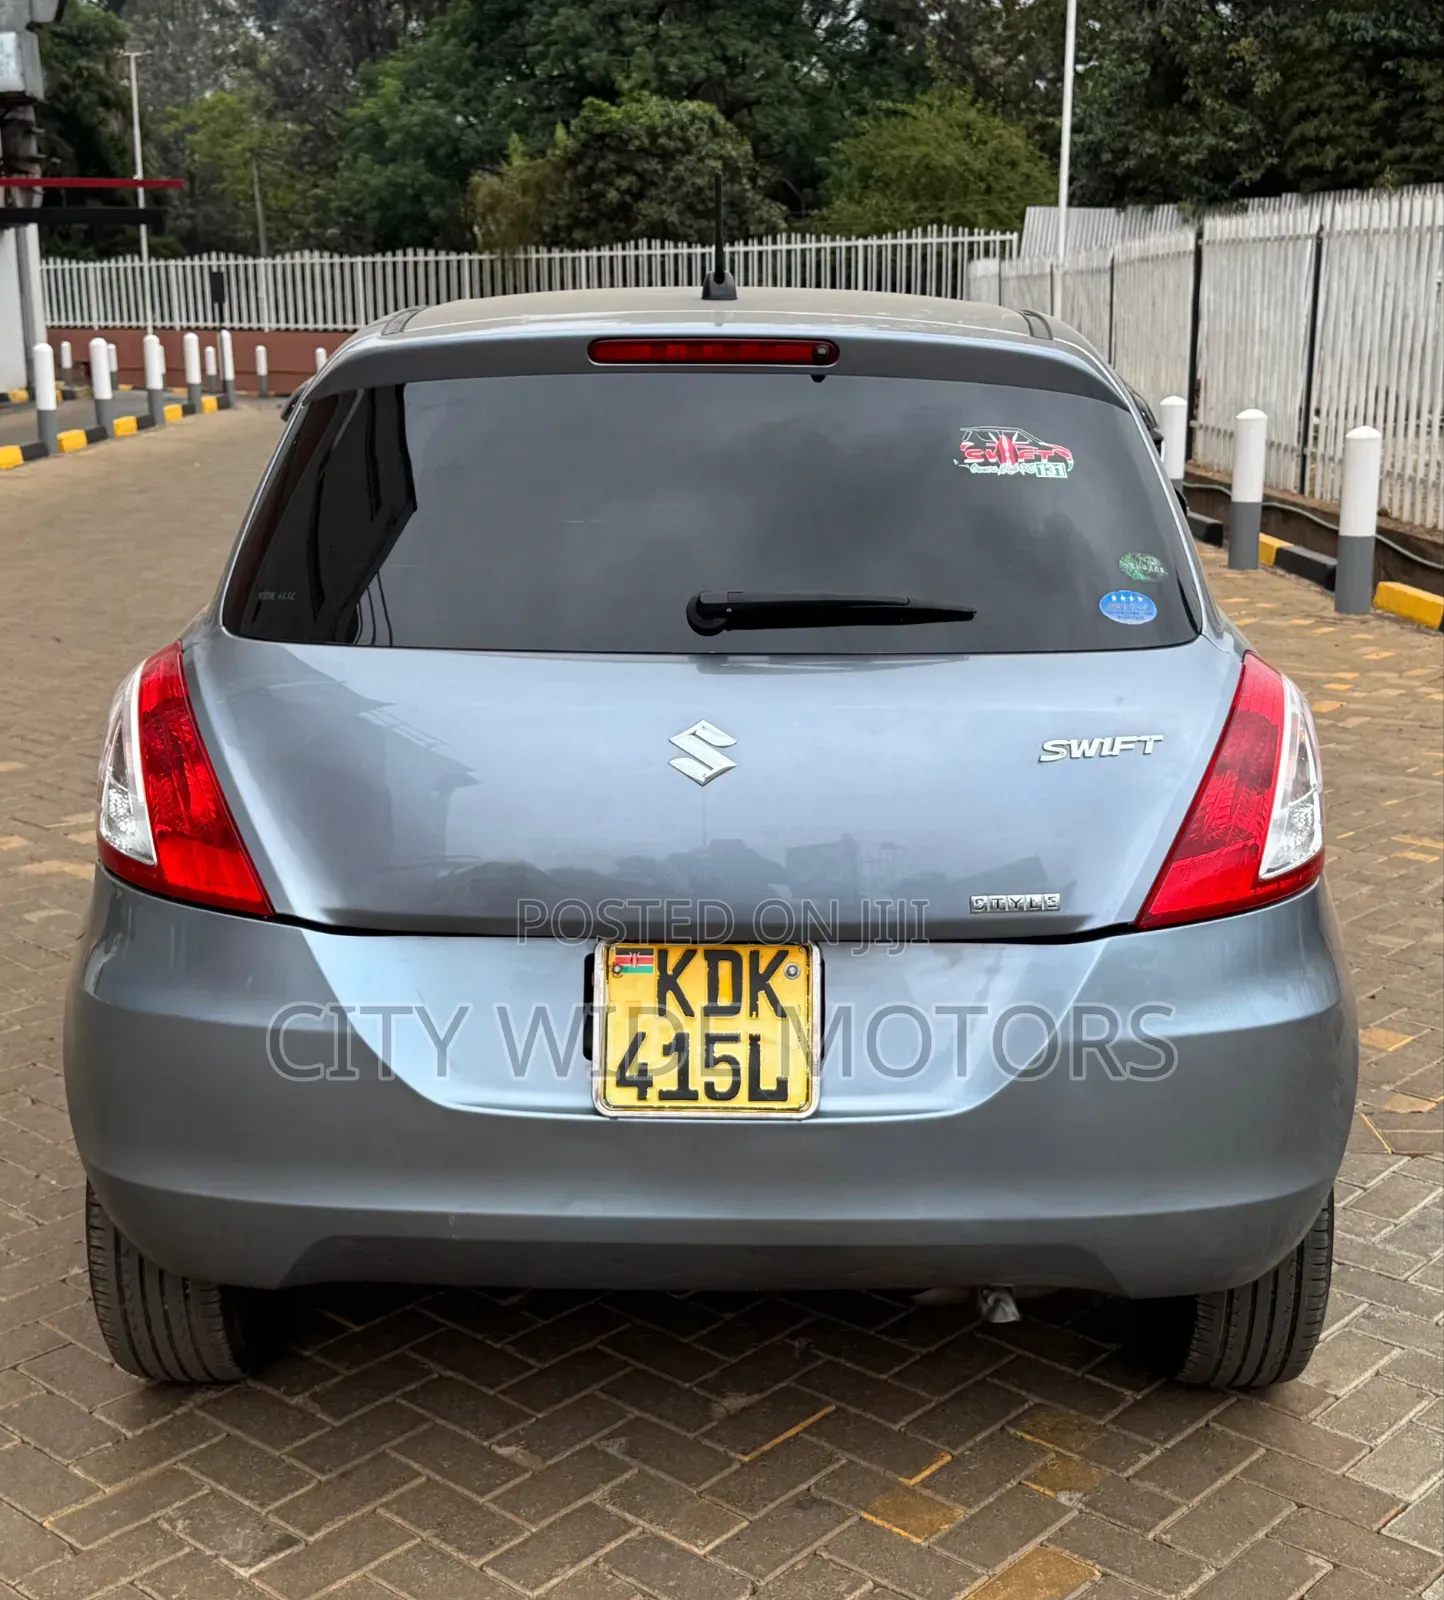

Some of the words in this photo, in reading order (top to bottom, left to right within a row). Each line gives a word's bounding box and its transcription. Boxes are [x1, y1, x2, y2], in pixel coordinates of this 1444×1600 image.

[1037, 463, 1065, 476] 131
[1038, 734, 1164, 763] SWIFT
[970, 893, 1060, 914] STYLE
[657, 949, 789, 1018] KDK
[615, 1031, 789, 1102] 415L
